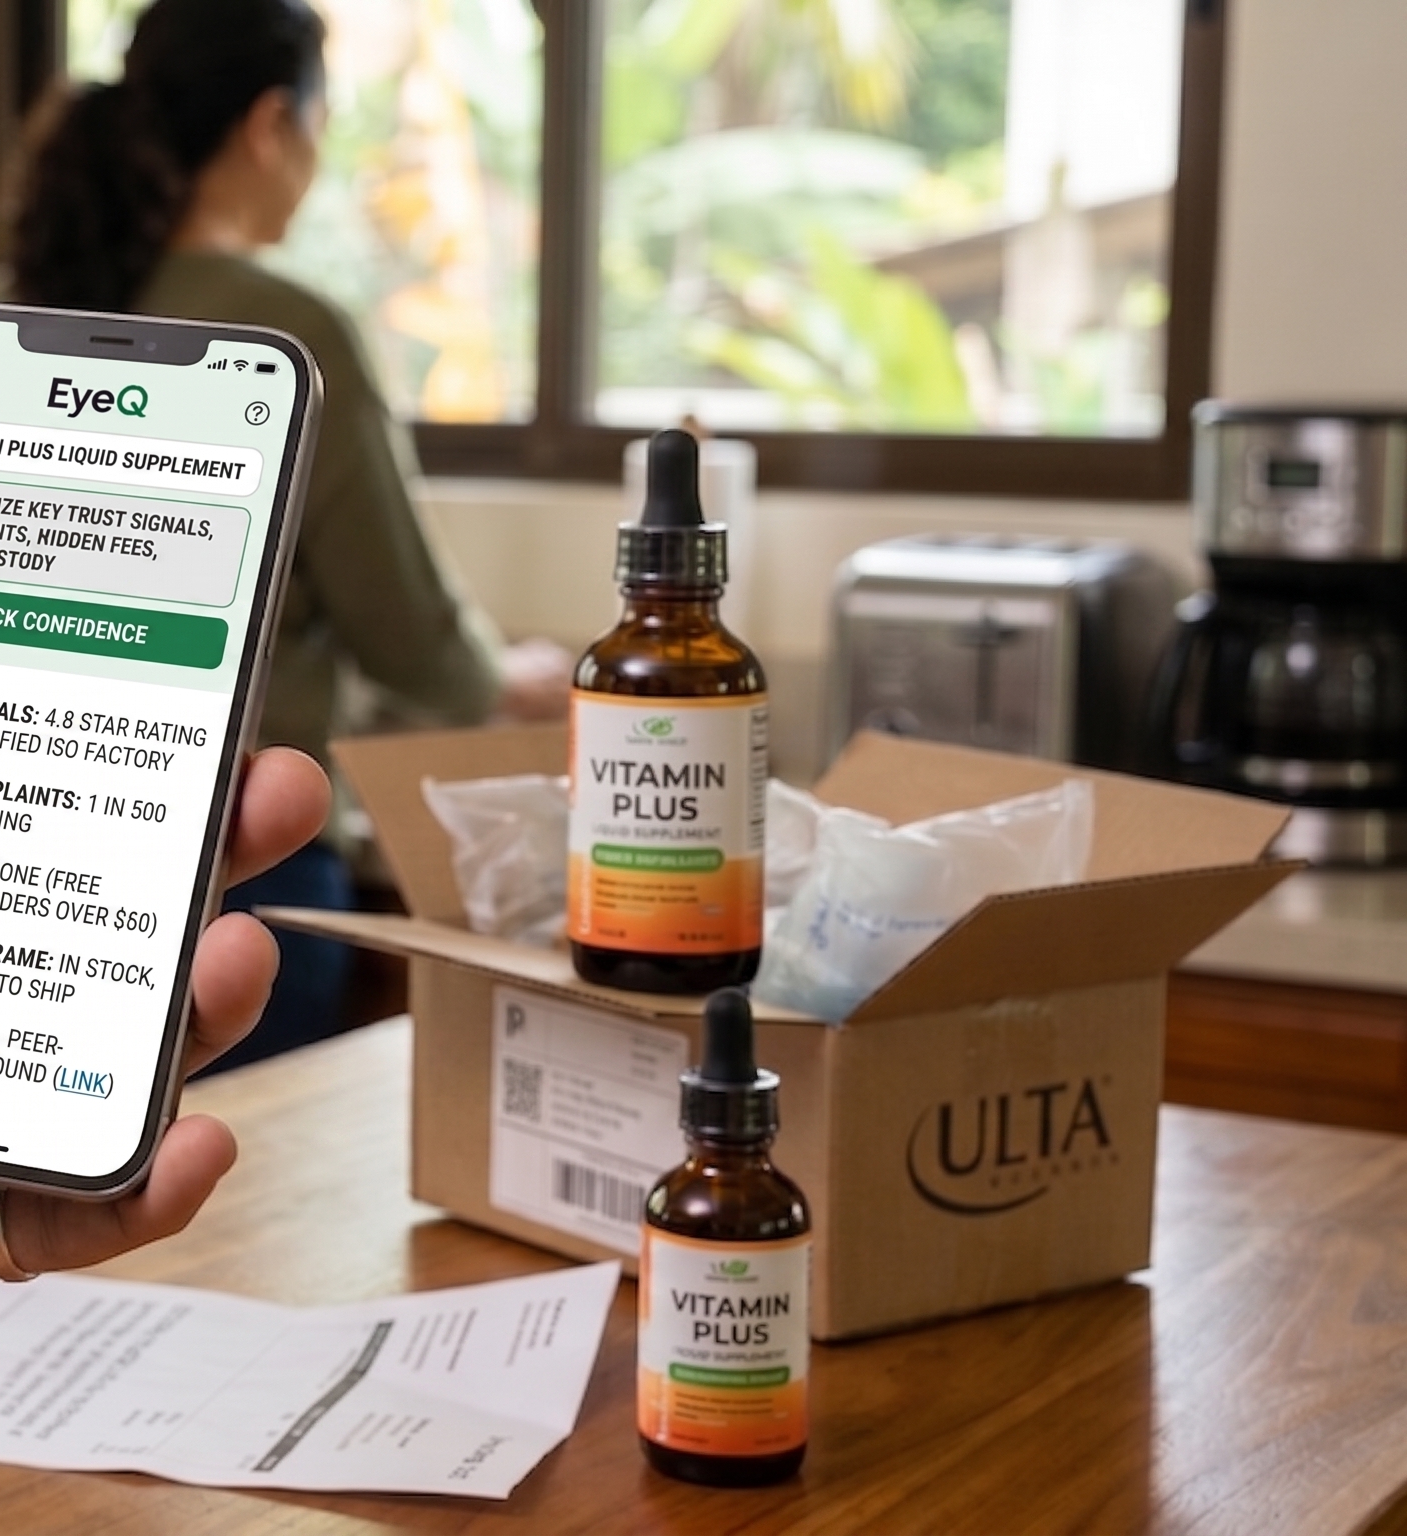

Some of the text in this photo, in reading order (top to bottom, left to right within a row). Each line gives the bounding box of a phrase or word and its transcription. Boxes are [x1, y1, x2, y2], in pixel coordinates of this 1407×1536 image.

[47, 376, 149, 418] EyeQ
[7, 439, 55, 460] PLUS
[57, 444, 118, 467] LIQUID
[121, 451, 246, 480] SUPPLEMENT
[27, 500, 64, 521] KEY
[67, 504, 128, 528] TRUST
[130, 512, 213, 541] SIGNALS,
[109, 536, 158, 561] FEES,
[22, 611, 149, 645] CONFIDENCE
[44, 708, 75, 730] 4.8
[79, 712, 130, 737] STAR
[134, 719, 207, 747] RATING
[46, 736, 79, 759] ISO
[83, 741, 175, 772] FACTORY
[591, 758, 726, 790] VITAMIN
[89, 794, 97, 813] 1
[103, 795, 126, 818] IN
[130, 799, 167, 823] 500
[612, 793, 699, 821] PLUS
[45, 867, 103, 896] (FREE
[55, 900, 109, 927] OVER
[113, 906, 157, 939] $60)
[58, 953, 81, 976] IN
[85, 958, 154, 987] STOCK,
[27, 978, 76, 1004] SHIP
[7, 1028, 64, 1056] PEER-
[52, 1065, 114, 1100] (LINK)
[938, 1077, 1111, 1176] ULTA
[671, 1288, 790, 1318] VITAMIN
[693, 1320, 769, 1346] PLUS
